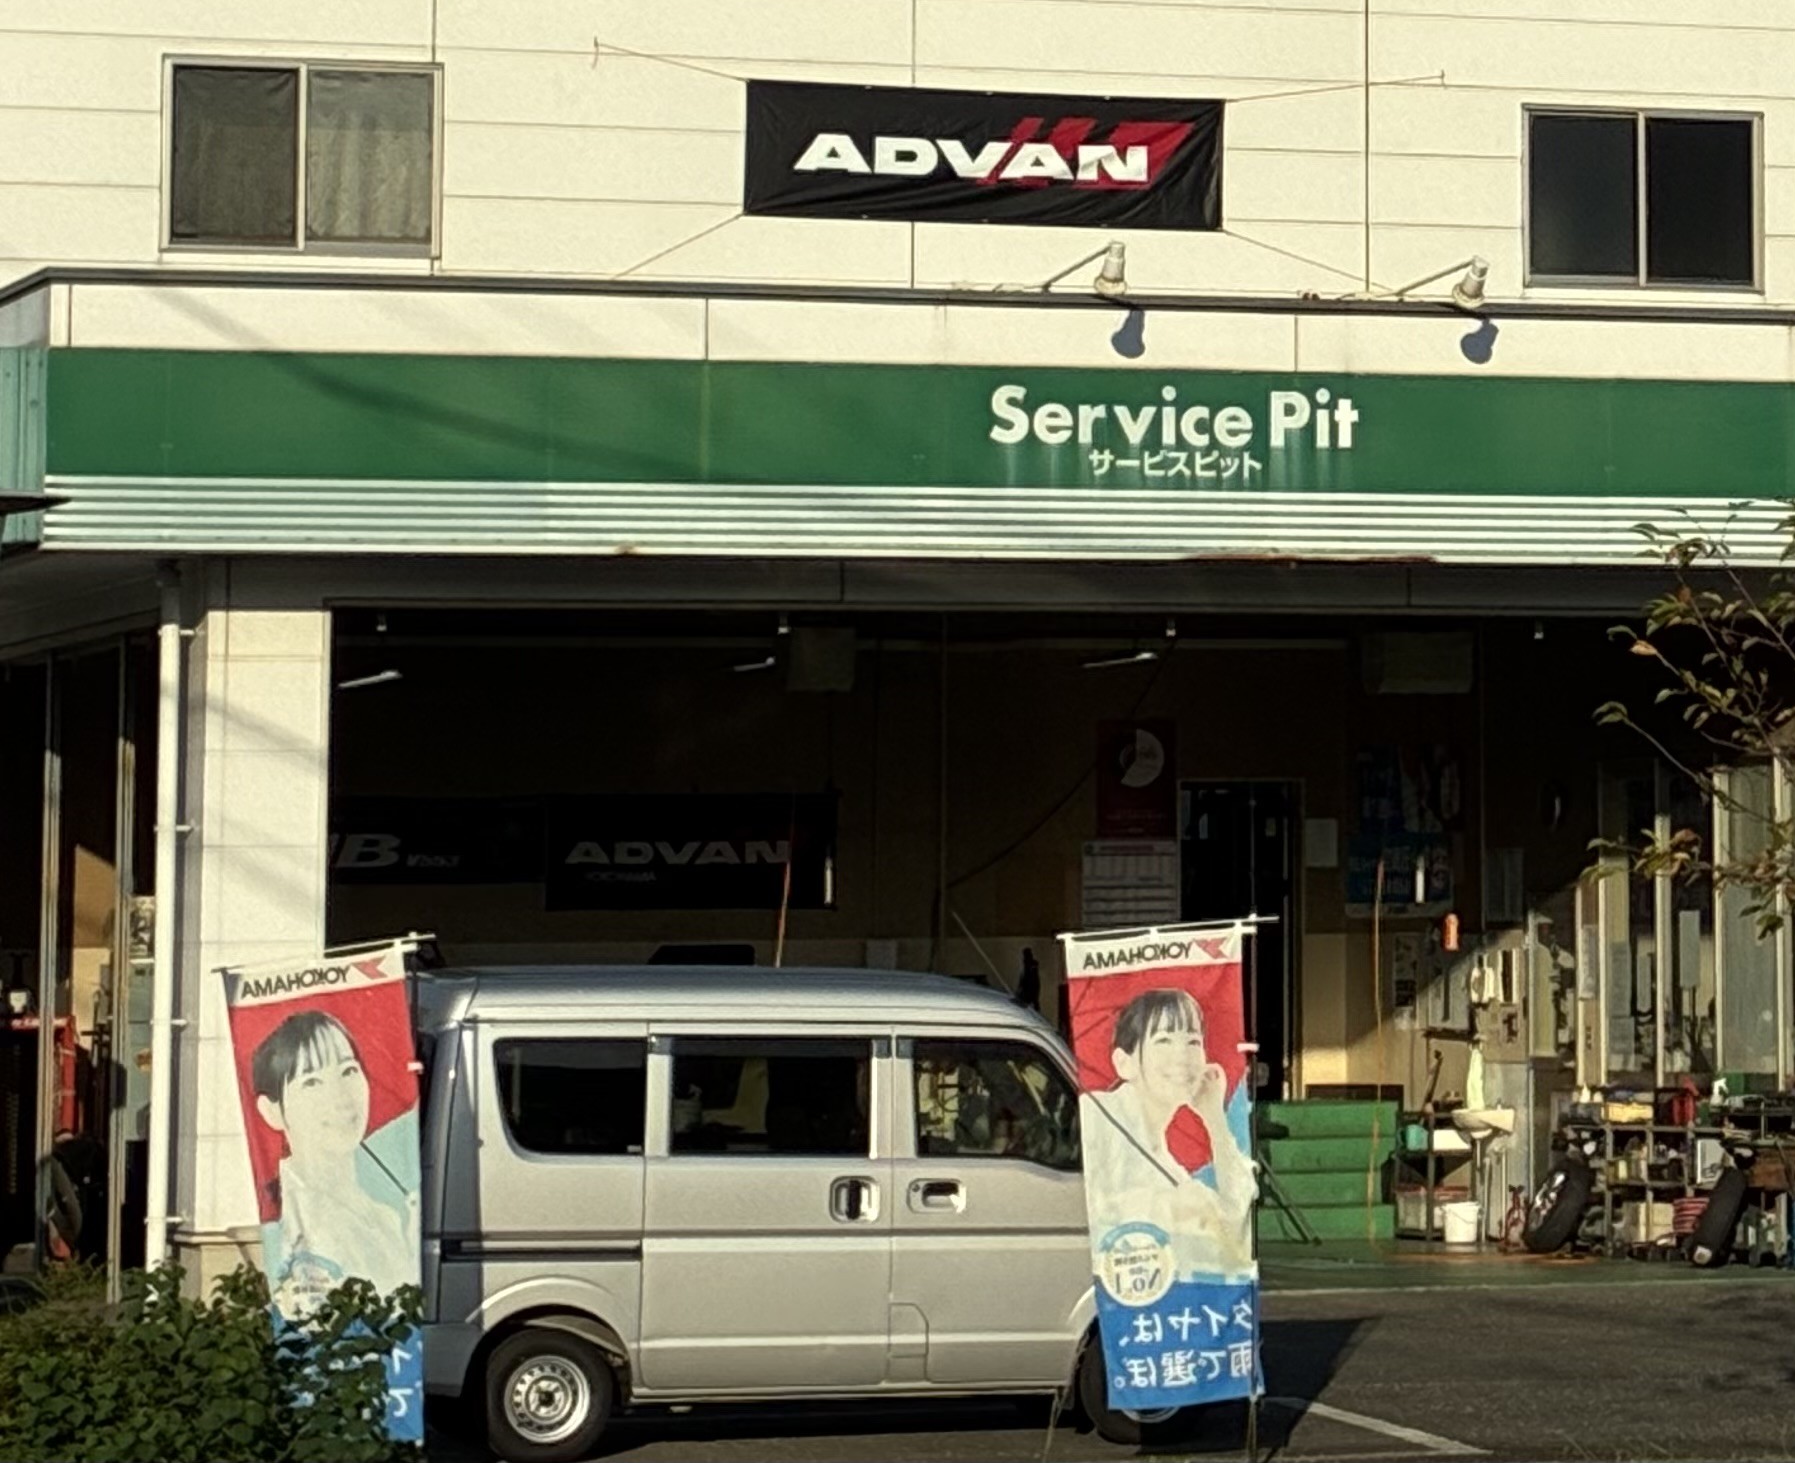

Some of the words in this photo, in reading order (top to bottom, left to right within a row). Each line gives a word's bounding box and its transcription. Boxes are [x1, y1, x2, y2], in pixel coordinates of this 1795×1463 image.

[793, 133, 1149, 182] ADVAN
[989, 384, 1254, 447] Service
[1269, 387, 1359, 449] Pit
[1088, 449, 1263, 479] サービスピット
[563, 839, 792, 865] ADVAN
